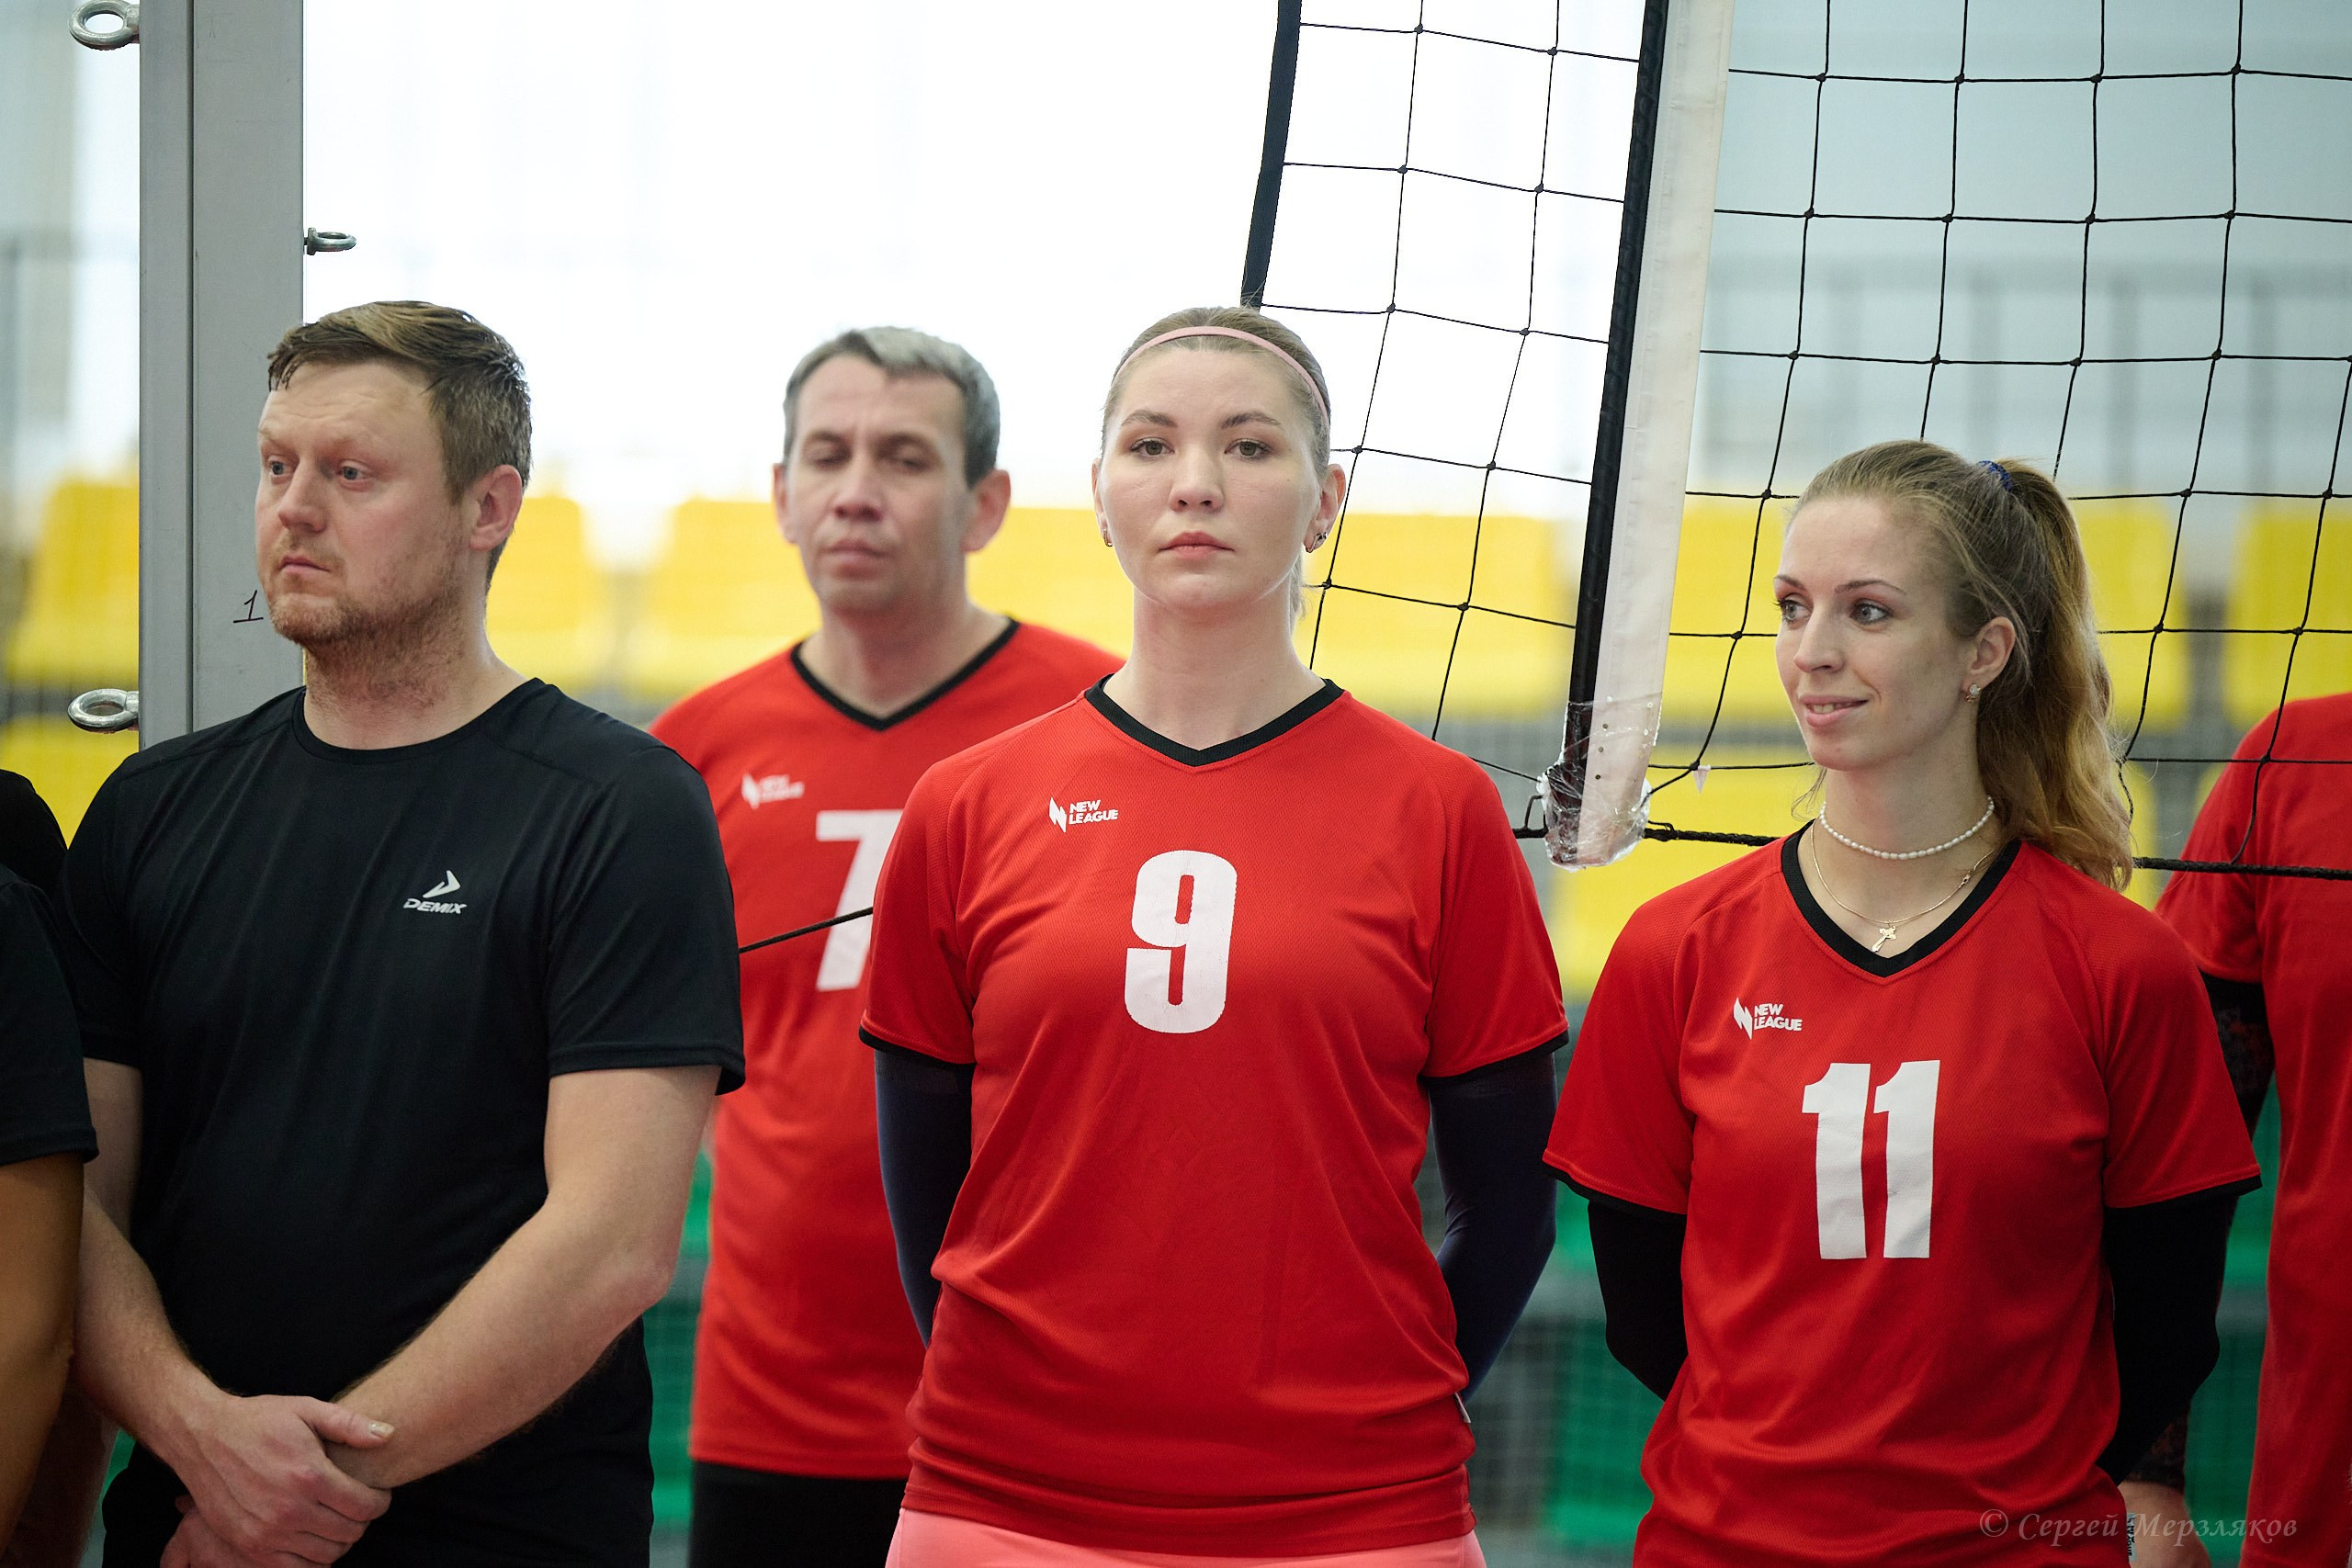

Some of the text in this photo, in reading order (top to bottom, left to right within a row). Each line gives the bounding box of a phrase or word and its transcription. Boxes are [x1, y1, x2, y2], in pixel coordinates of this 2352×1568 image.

[233, 590, 264, 623] 1
[1069, 799, 1101, 813] NEW
[1069, 809, 1118, 825] LEAGUE
[403, 898, 468, 914] DEMIX
[816, 809, 903, 991] 7
[1125, 850, 1238, 1034] 9
[1754, 1003, 1783, 1017] NEW
[1754, 1016, 1803, 1031] LEAGUE
[1802, 1060, 1940, 1259] 11
